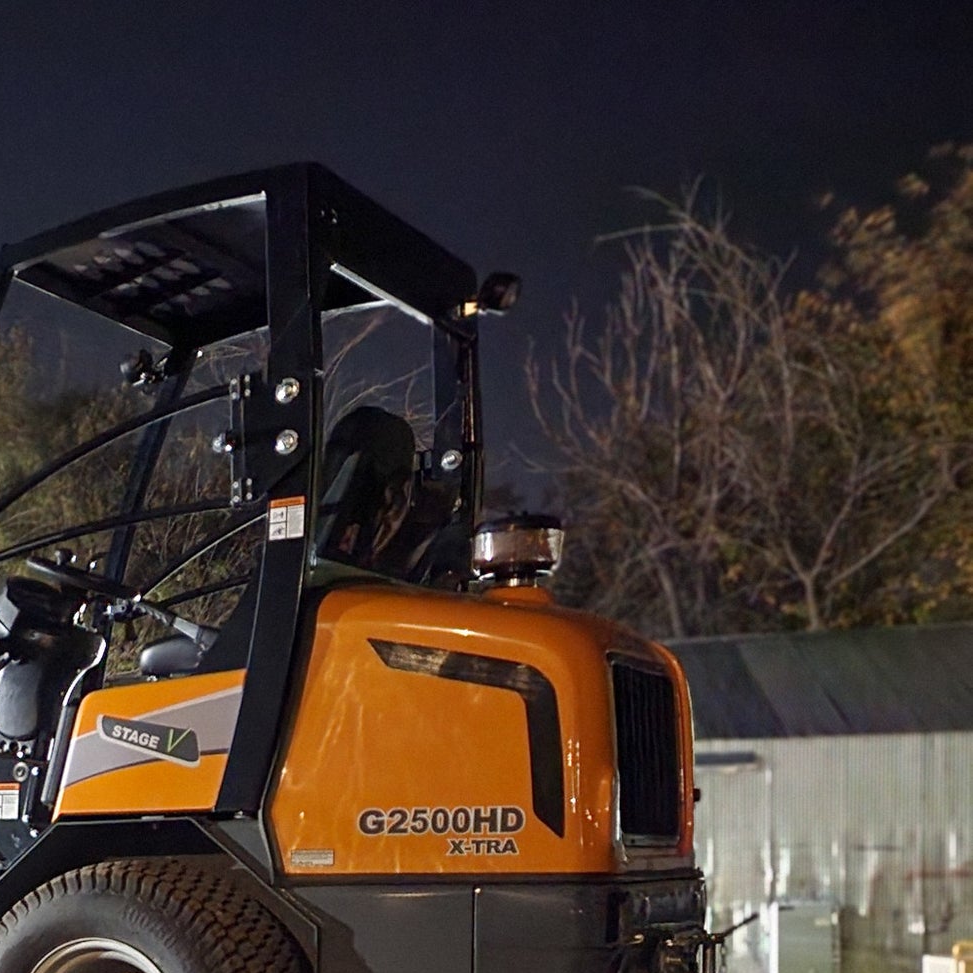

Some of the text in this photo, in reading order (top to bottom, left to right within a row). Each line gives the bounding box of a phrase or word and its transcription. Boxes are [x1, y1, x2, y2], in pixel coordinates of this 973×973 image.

[111, 725, 161, 749] STAGE
[358, 805, 525, 836] G2500HD
[447, 837, 520, 856] X-TRA
